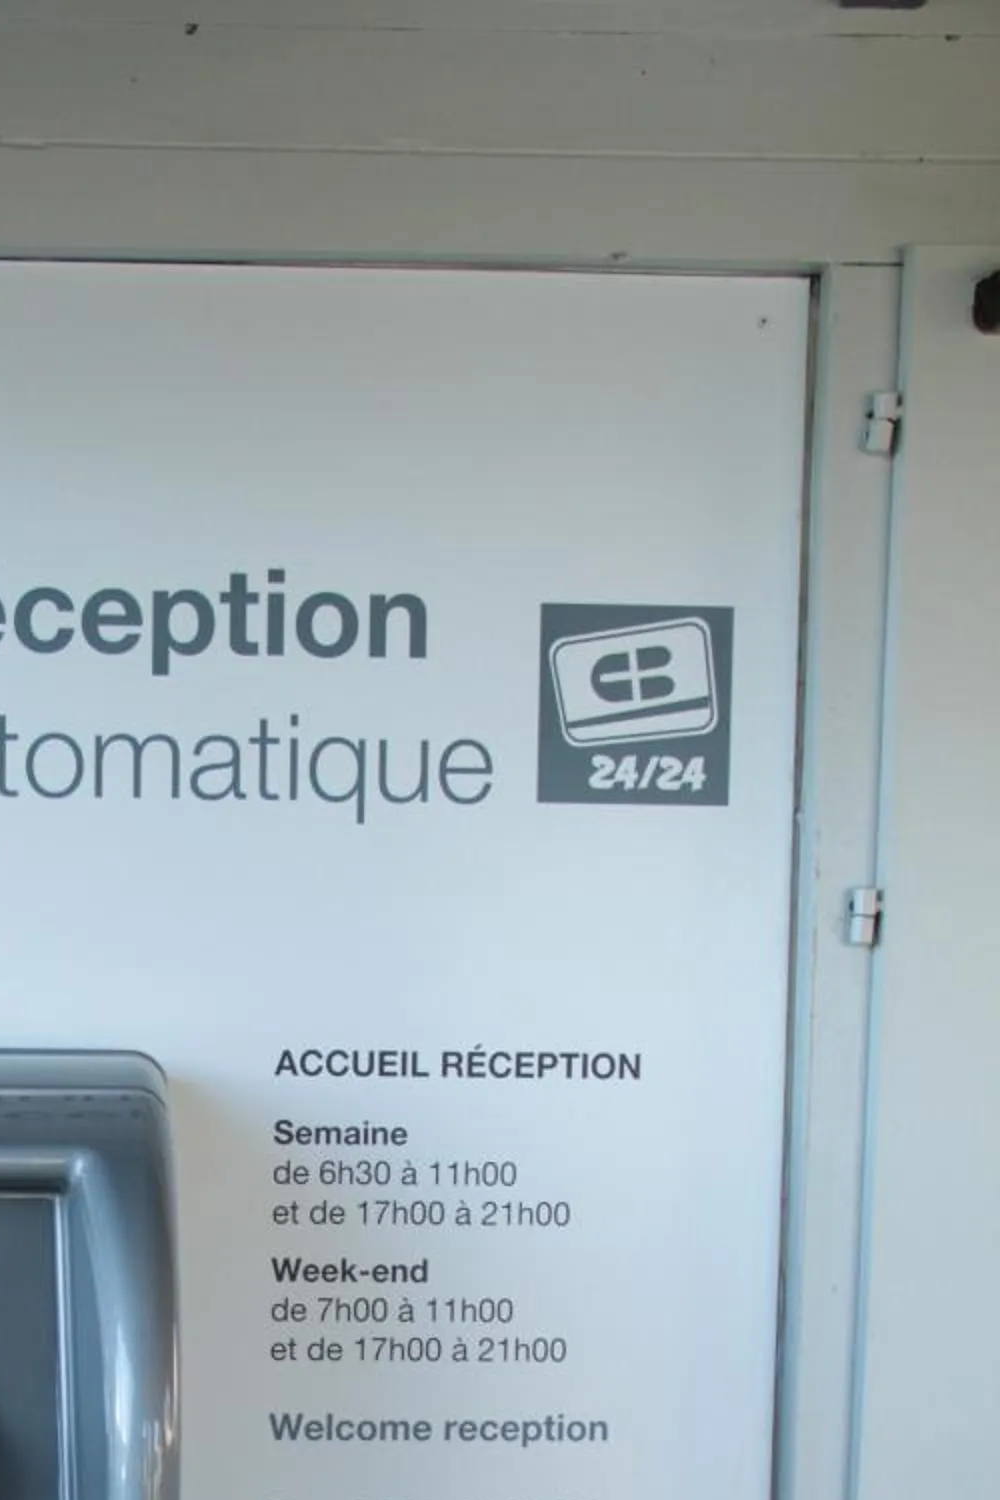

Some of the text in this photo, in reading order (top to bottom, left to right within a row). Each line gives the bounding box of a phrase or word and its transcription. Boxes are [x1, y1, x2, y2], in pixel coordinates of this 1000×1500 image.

[588, 754, 707, 792] 24/24
[274, 1044, 641, 1081] ACCUEIL RÉCEPTION
[273, 1119, 409, 1147] Semaine
[273, 1159, 517, 1187] de 6h30 à 11h00
[271, 1199, 571, 1228] et de 17h00 à 21h00
[271, 1257, 429, 1284] Week-end
[270, 1296, 514, 1324] de 7h00 à 11h00
[269, 1336, 567, 1364] et de 17h00 à 21h00
[268, 1412, 609, 1449] Welcome reception
